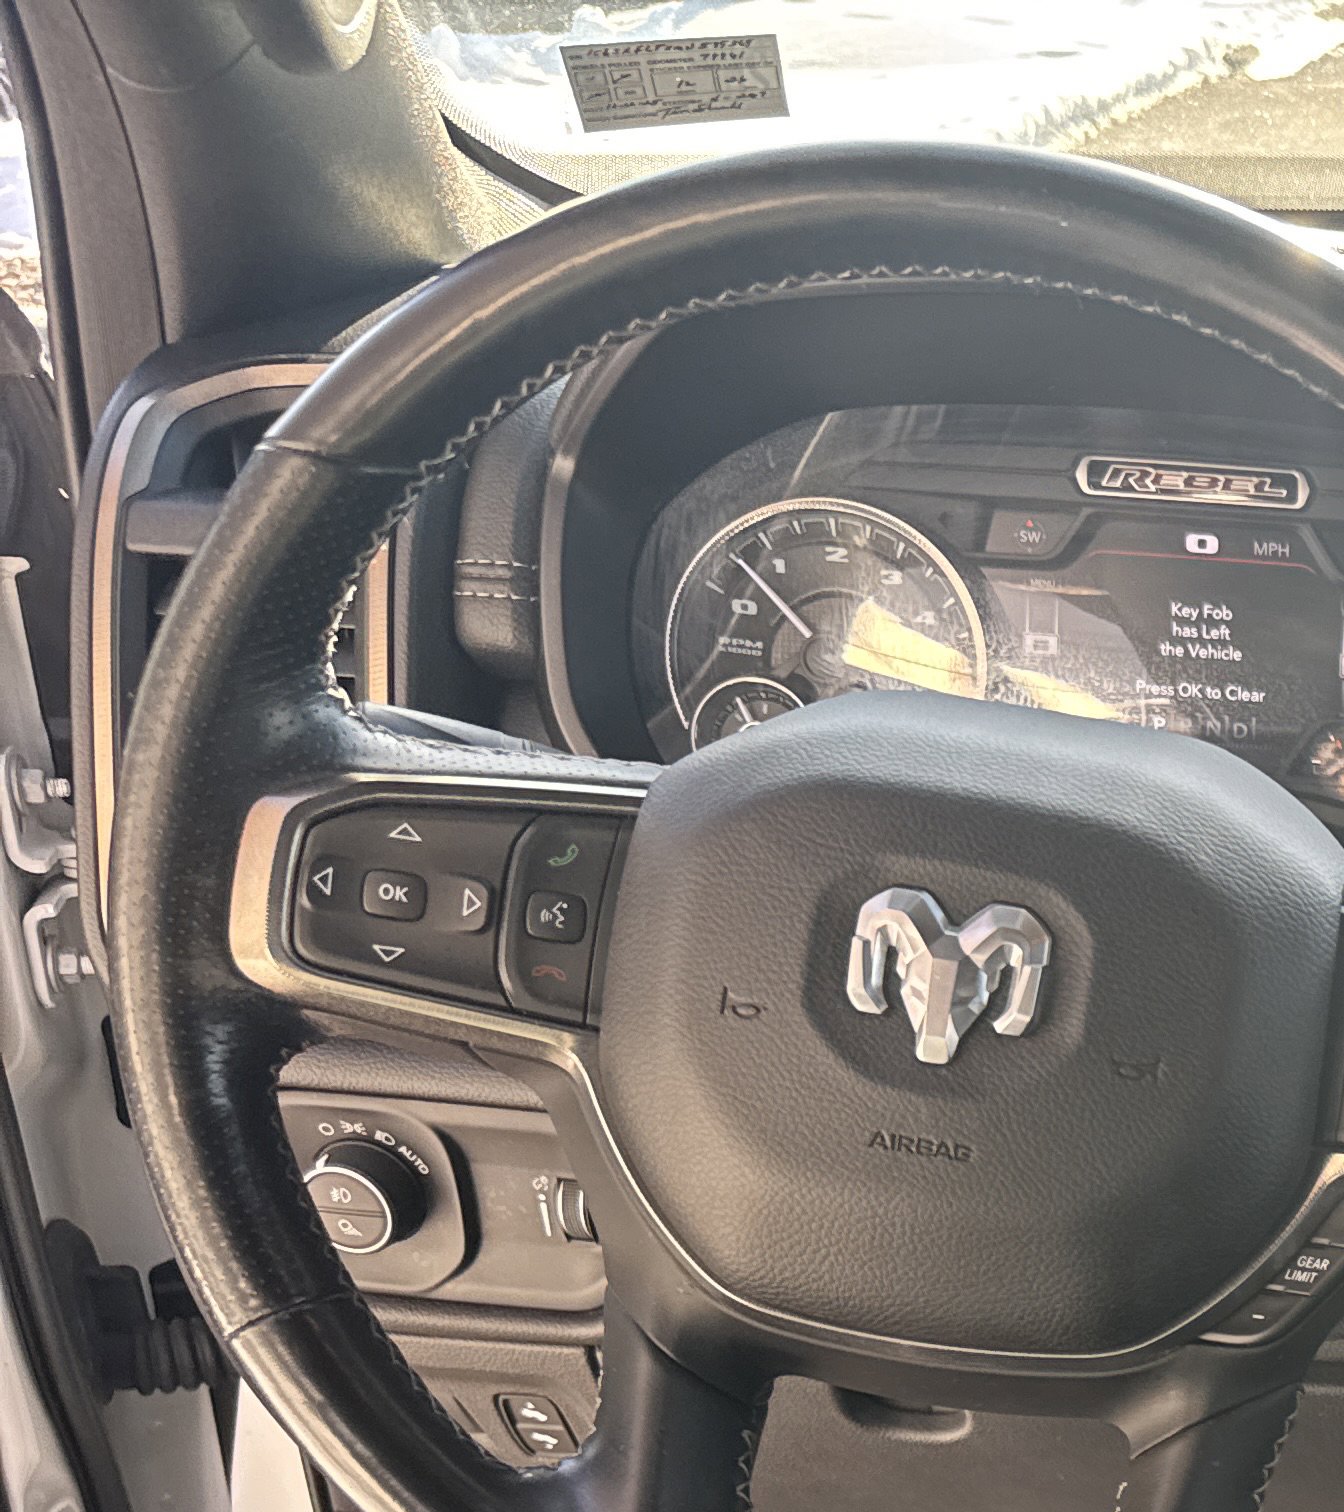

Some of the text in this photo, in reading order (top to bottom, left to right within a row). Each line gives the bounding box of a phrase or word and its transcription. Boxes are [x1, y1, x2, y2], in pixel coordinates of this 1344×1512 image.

[1100, 464, 1288, 498] REBEL
[1019, 530, 1042, 544] SW
[825, 546, 849, 563] 2
[1253, 541, 1290, 558] MPH
[772, 558, 786, 574] 1
[881, 570, 903, 585] 3
[731, 599, 758, 615] 0
[1171, 602, 1233, 621] Key Fob
[1172, 622, 1231, 641] has Left
[1160, 643, 1243, 662] the Vehicle
[1136, 680, 1266, 704] Press OK to Clear
[377, 883, 409, 903] OK
[868, 1129, 975, 1163] AIRBAG
[398, 1144, 430, 1176] AUTO
[1297, 1255, 1331, 1271] GEAR
[1284, 1269, 1319, 1284] LIMIT
